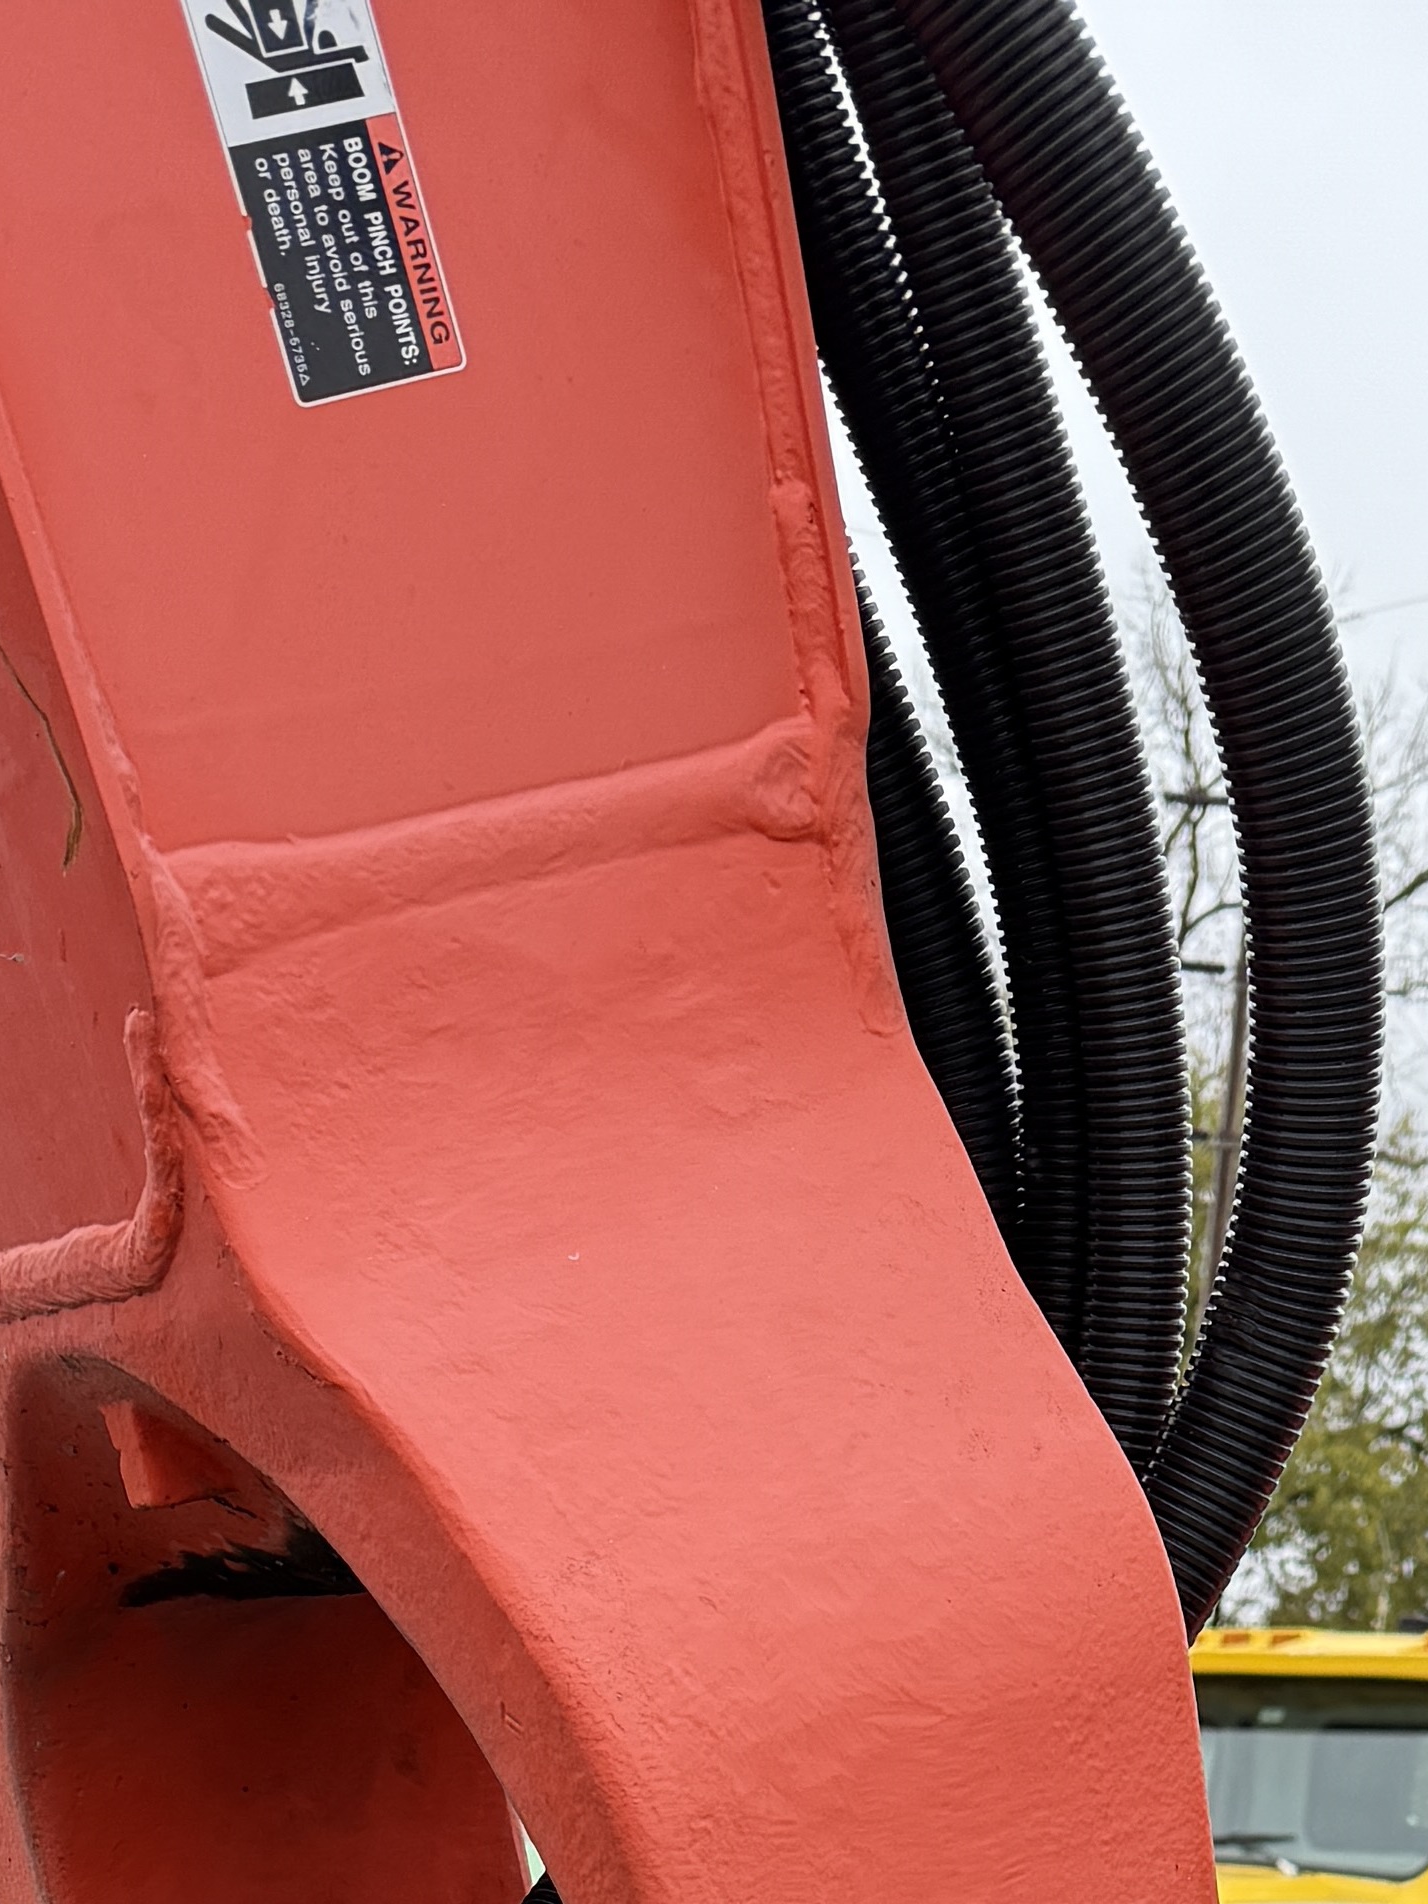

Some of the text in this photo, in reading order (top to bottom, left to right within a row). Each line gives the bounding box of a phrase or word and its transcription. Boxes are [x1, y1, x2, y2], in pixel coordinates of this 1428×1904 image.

[254, 157, 293, 257] or death.
[272, 152, 332, 314] personal injury
[297, 148, 371, 376] area to avoid serious
[319, 142, 377, 320] Keep out of this
[343, 136, 420, 365] BOOM PINCH POINTS:
[392, 180, 450, 346] WARNING
